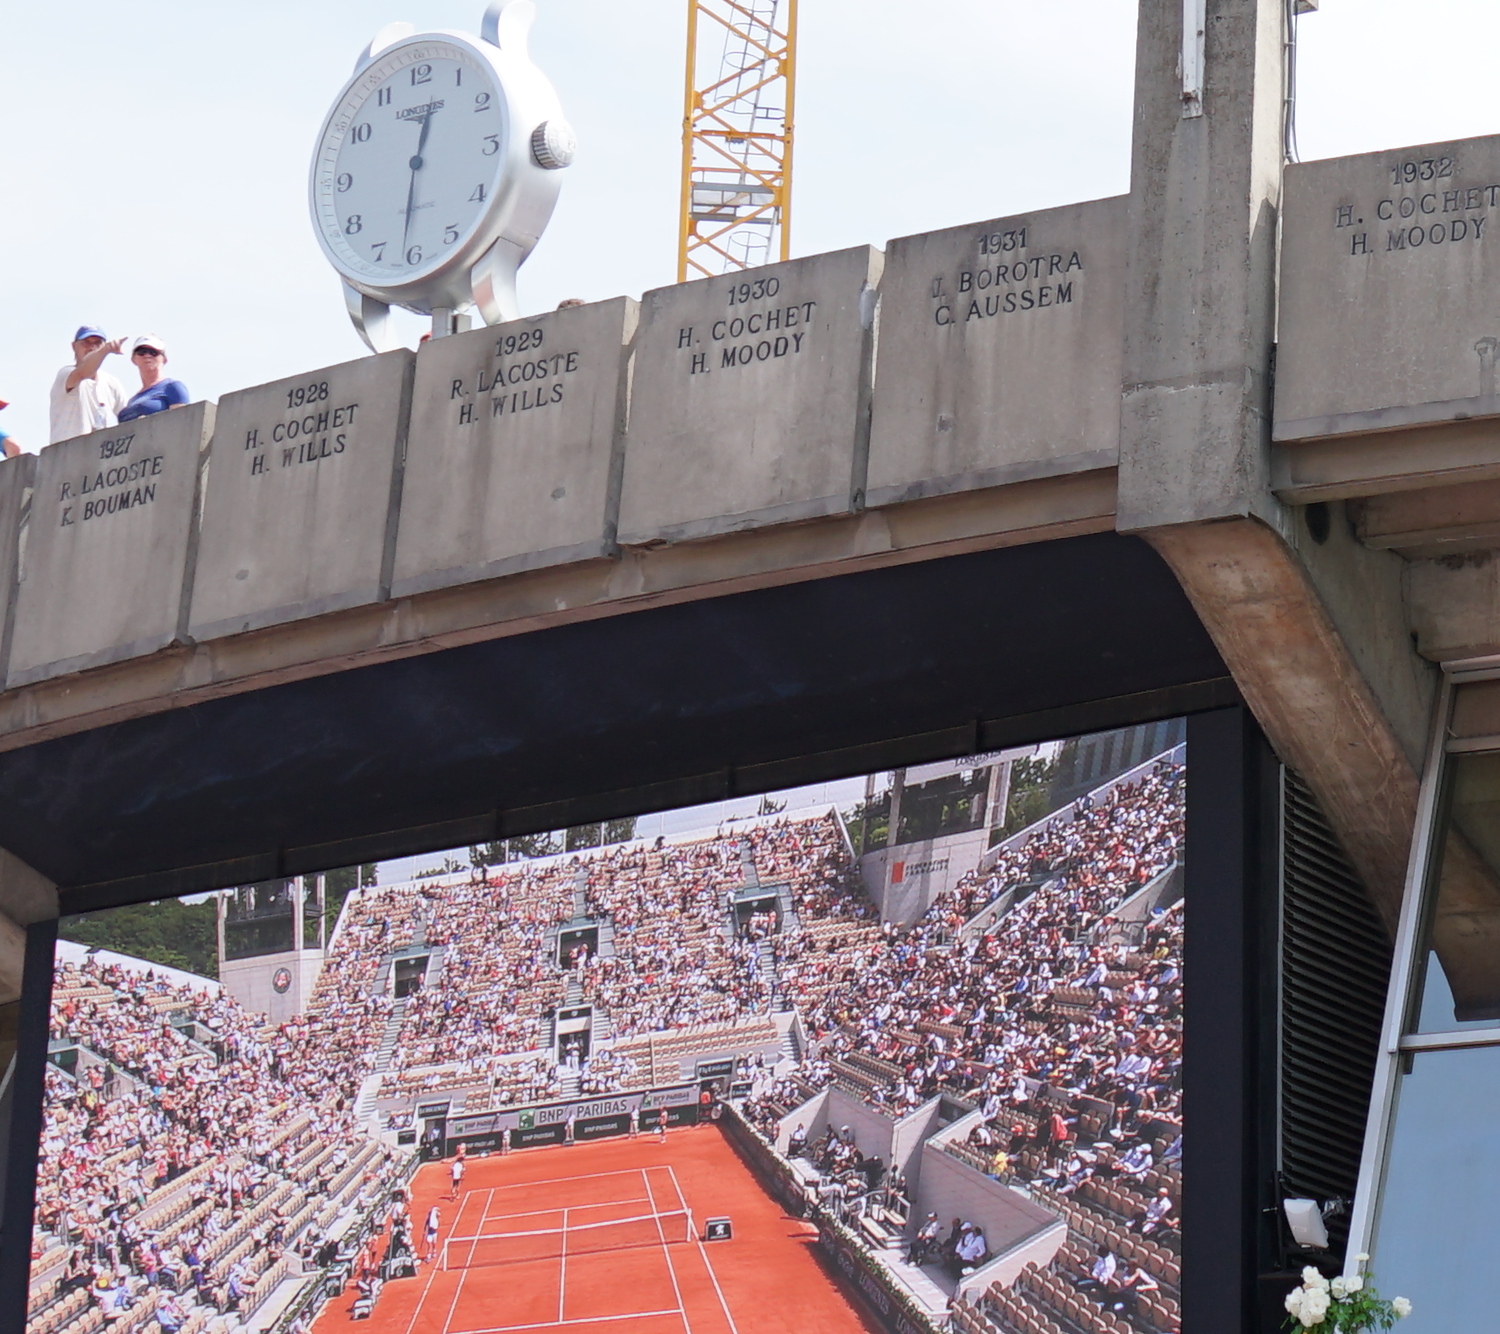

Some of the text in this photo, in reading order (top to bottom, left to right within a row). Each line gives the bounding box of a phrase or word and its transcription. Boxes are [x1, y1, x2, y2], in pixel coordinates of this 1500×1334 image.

[410, 64, 432, 86] 12
[454, 67, 462, 87] 1
[377, 86, 391, 107] 11
[395, 99, 445, 120] LONGINES
[474, 92, 490, 113] 2
[350, 122, 372, 145] 10
[482, 134, 499, 156] 3
[337, 173, 353, 192] 9
[1390, 157, 1454, 186] 1932
[468, 183, 487, 203] 4
[345, 214, 362, 235] 8
[1336, 205, 1364, 229] H.
[443, 223, 459, 245] 5
[979, 227, 1027, 255] 1931
[1349, 217, 1487, 257] H. MOODY
[370, 240, 387, 262] 7
[406, 245, 422, 265] 6
[958, 250, 1083, 294] BOROTRA
[728, 277, 781, 306] 1930
[965, 282, 1074, 322] AUSSEM
[678, 301, 817, 349] H. COCHET
[495, 329, 544, 357] 1929
[690, 332, 806, 374] H. MOODY
[450, 351, 580, 399] R. LACOSTE
[286, 381, 330, 409] 1928
[458, 383, 564, 425] H. WILLS
[245, 403, 359, 451] H. COCHET
[99, 434, 135, 459] 1927
[251, 432, 347, 475] H. WILLS
[59, 455, 163, 501] R. LACOSTE
[61, 483, 157, 527] K. BOUMAN
[539, 1099, 627, 1124] BNP PARIBAS
